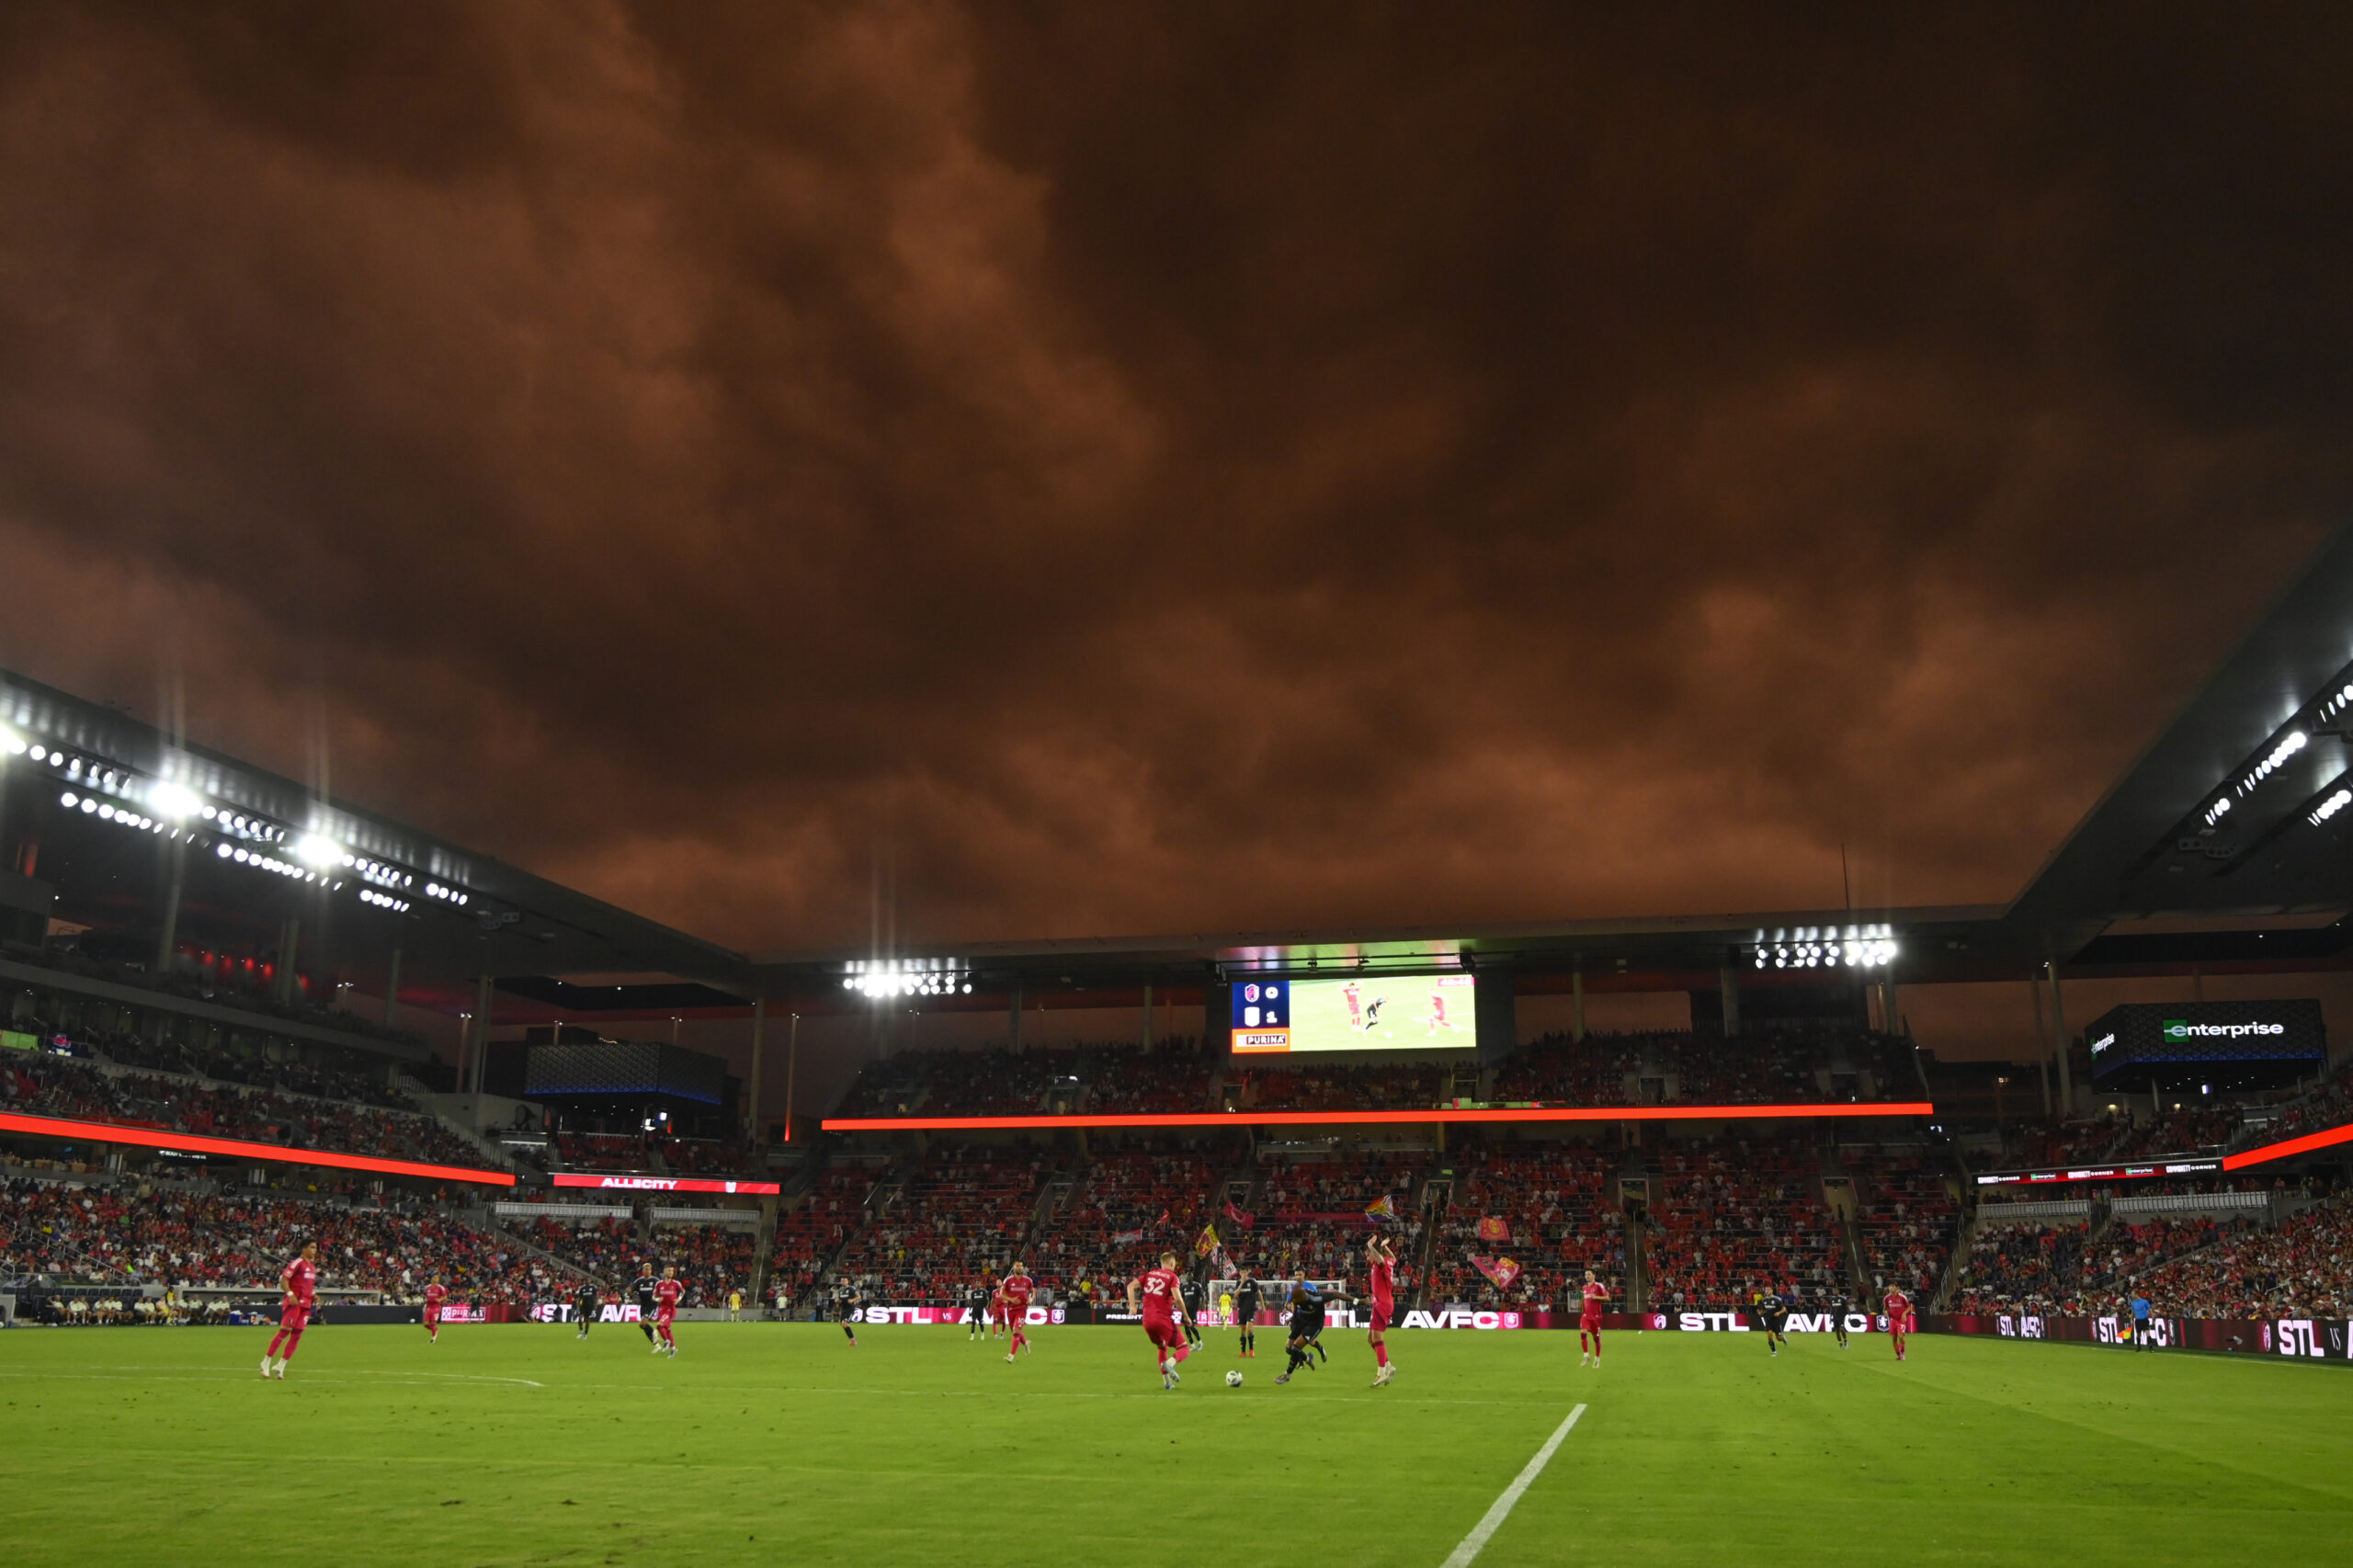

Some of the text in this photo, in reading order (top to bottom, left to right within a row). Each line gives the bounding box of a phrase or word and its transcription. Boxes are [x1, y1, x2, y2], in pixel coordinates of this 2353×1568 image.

[1266, 987, 1278, 998] 0
[1267, 1011, 1278, 1023] 1
[2164, 1021, 2284, 1038] enterprise
[1248, 1035, 1285, 1044] PURINA
[2091, 1033, 2115, 1053] enterprise
[1144, 1278, 1165, 1295] 32
[866, 1306, 932, 1324] STL
[1401, 1311, 1499, 1329] AVFC
[1679, 1313, 1750, 1331] STL
[2000, 1315, 2016, 1336] STL
[2098, 1317, 2123, 1344] STL
[2278, 1319, 2325, 1357] STL
